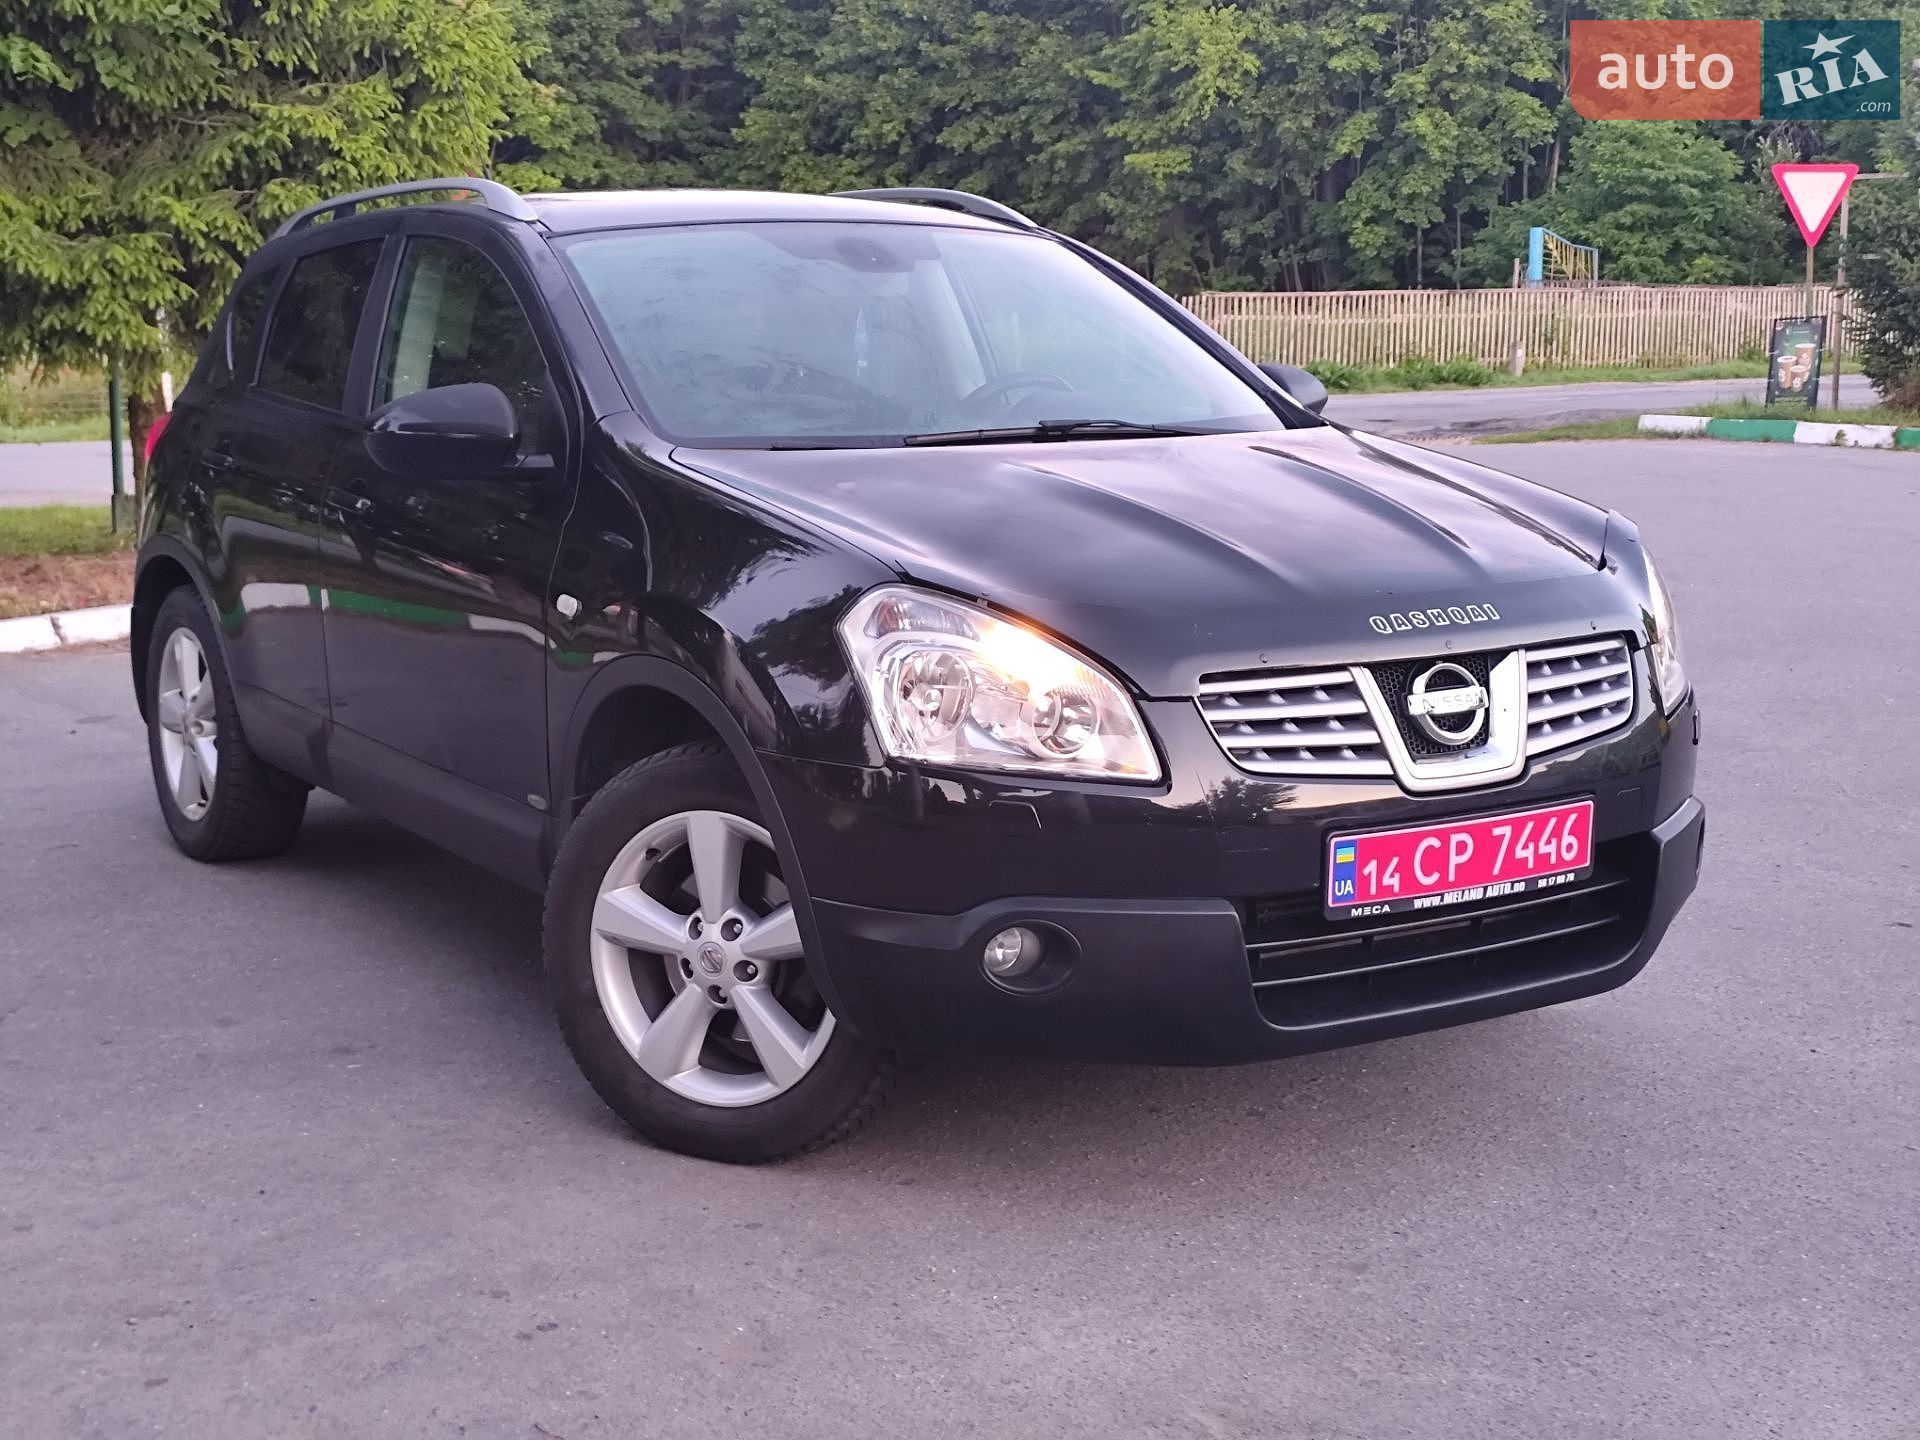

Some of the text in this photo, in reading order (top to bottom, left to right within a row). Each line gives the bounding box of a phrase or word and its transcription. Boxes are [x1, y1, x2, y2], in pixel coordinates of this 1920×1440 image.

[1369, 603, 1500, 634] QASHQAI
[1421, 689, 1484, 710] NISSAN
[1362, 812, 1579, 896] 14 CP 7446
[1335, 879, 1354, 897] UA
